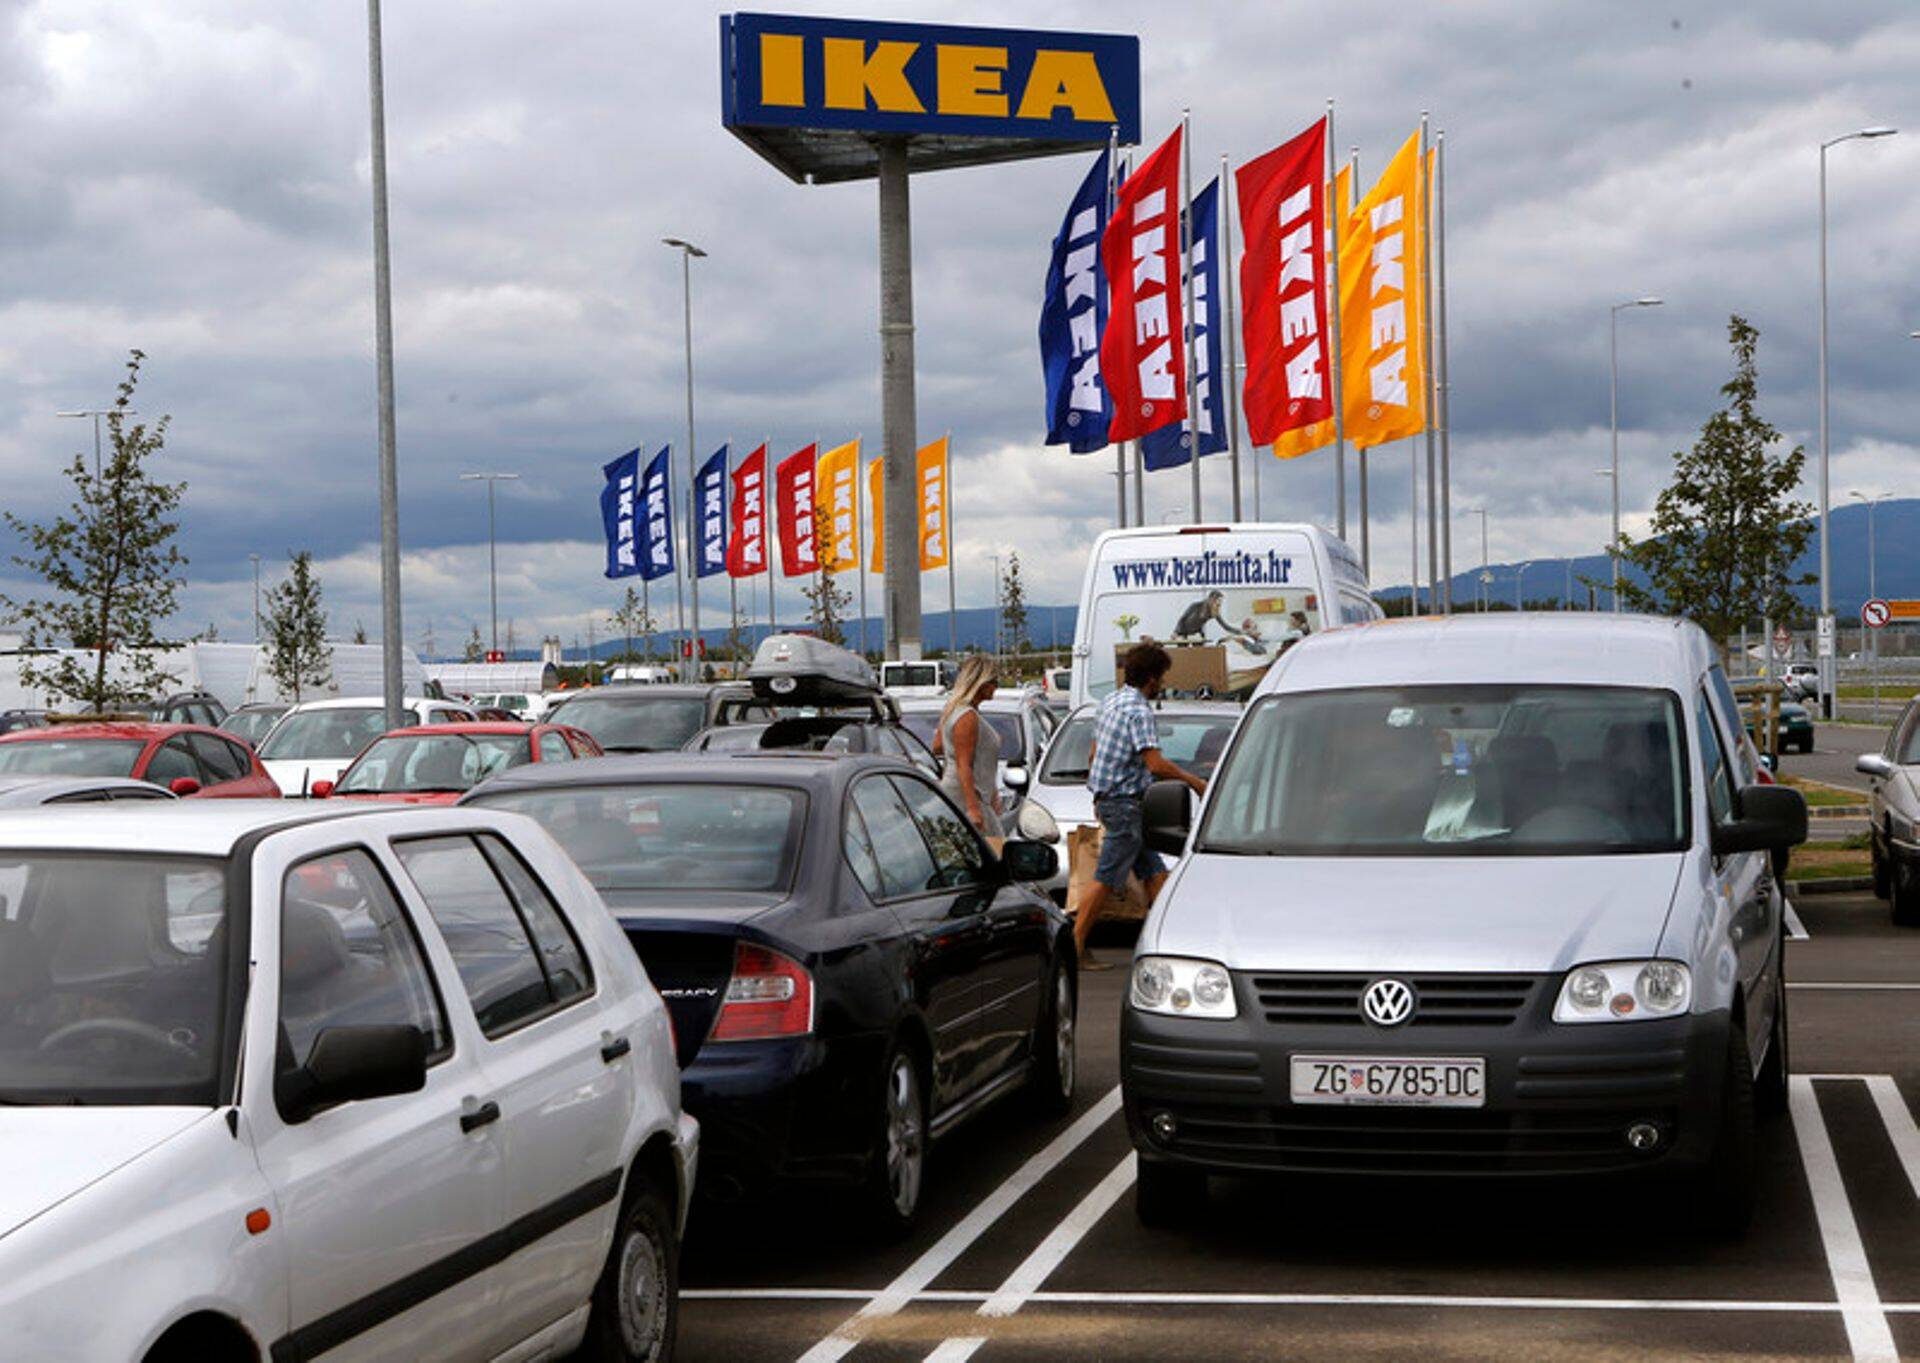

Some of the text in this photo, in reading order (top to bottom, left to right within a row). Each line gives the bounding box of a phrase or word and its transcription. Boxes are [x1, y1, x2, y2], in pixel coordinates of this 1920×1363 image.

[760, 33, 1118, 122] IKEA
[1065, 205, 1103, 413] IKEA
[1132, 188, 1177, 400] IKEA
[1278, 184, 1322, 400] IKEA
[1369, 195, 1408, 407] IKEA
[618, 475, 636, 566] IKEA
[648, 472, 669, 565] IKEA
[705, 471, 722, 563] IKEA
[743, 471, 761, 563] IKEA
[794, 470, 815, 562] IKEA
[834, 467, 854, 560] IKEA
[925, 465, 943, 558] IKEA
[1113, 549, 1292, 588] www.bezlimita.hr
[1313, 1064, 1347, 1094] ZG
